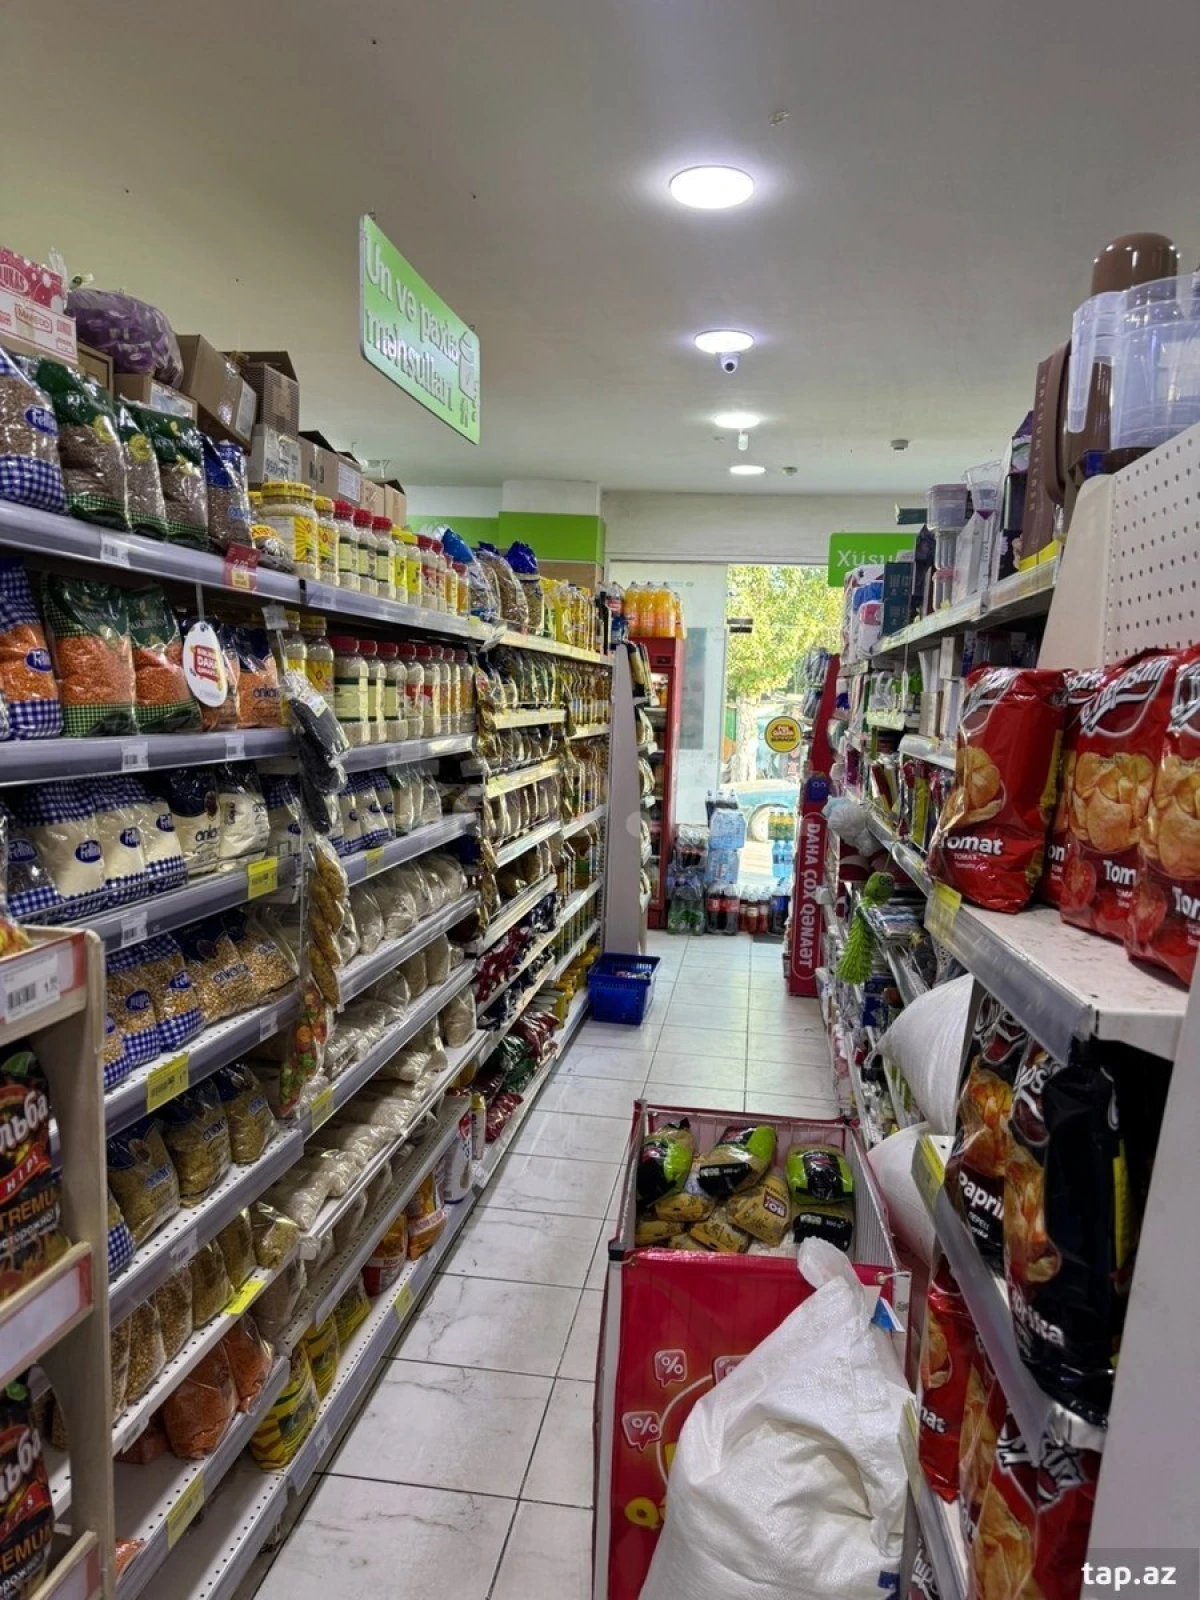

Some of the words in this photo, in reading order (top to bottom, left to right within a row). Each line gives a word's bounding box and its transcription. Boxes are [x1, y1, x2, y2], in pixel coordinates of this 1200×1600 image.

[364, 234, 392, 301] Un
[804, 823, 821, 866] DAHA
[939, 831, 1003, 856] Tomat
[803, 868, 818, 903] ÇOX
[799, 903, 816, 969] QƏNAƏT
